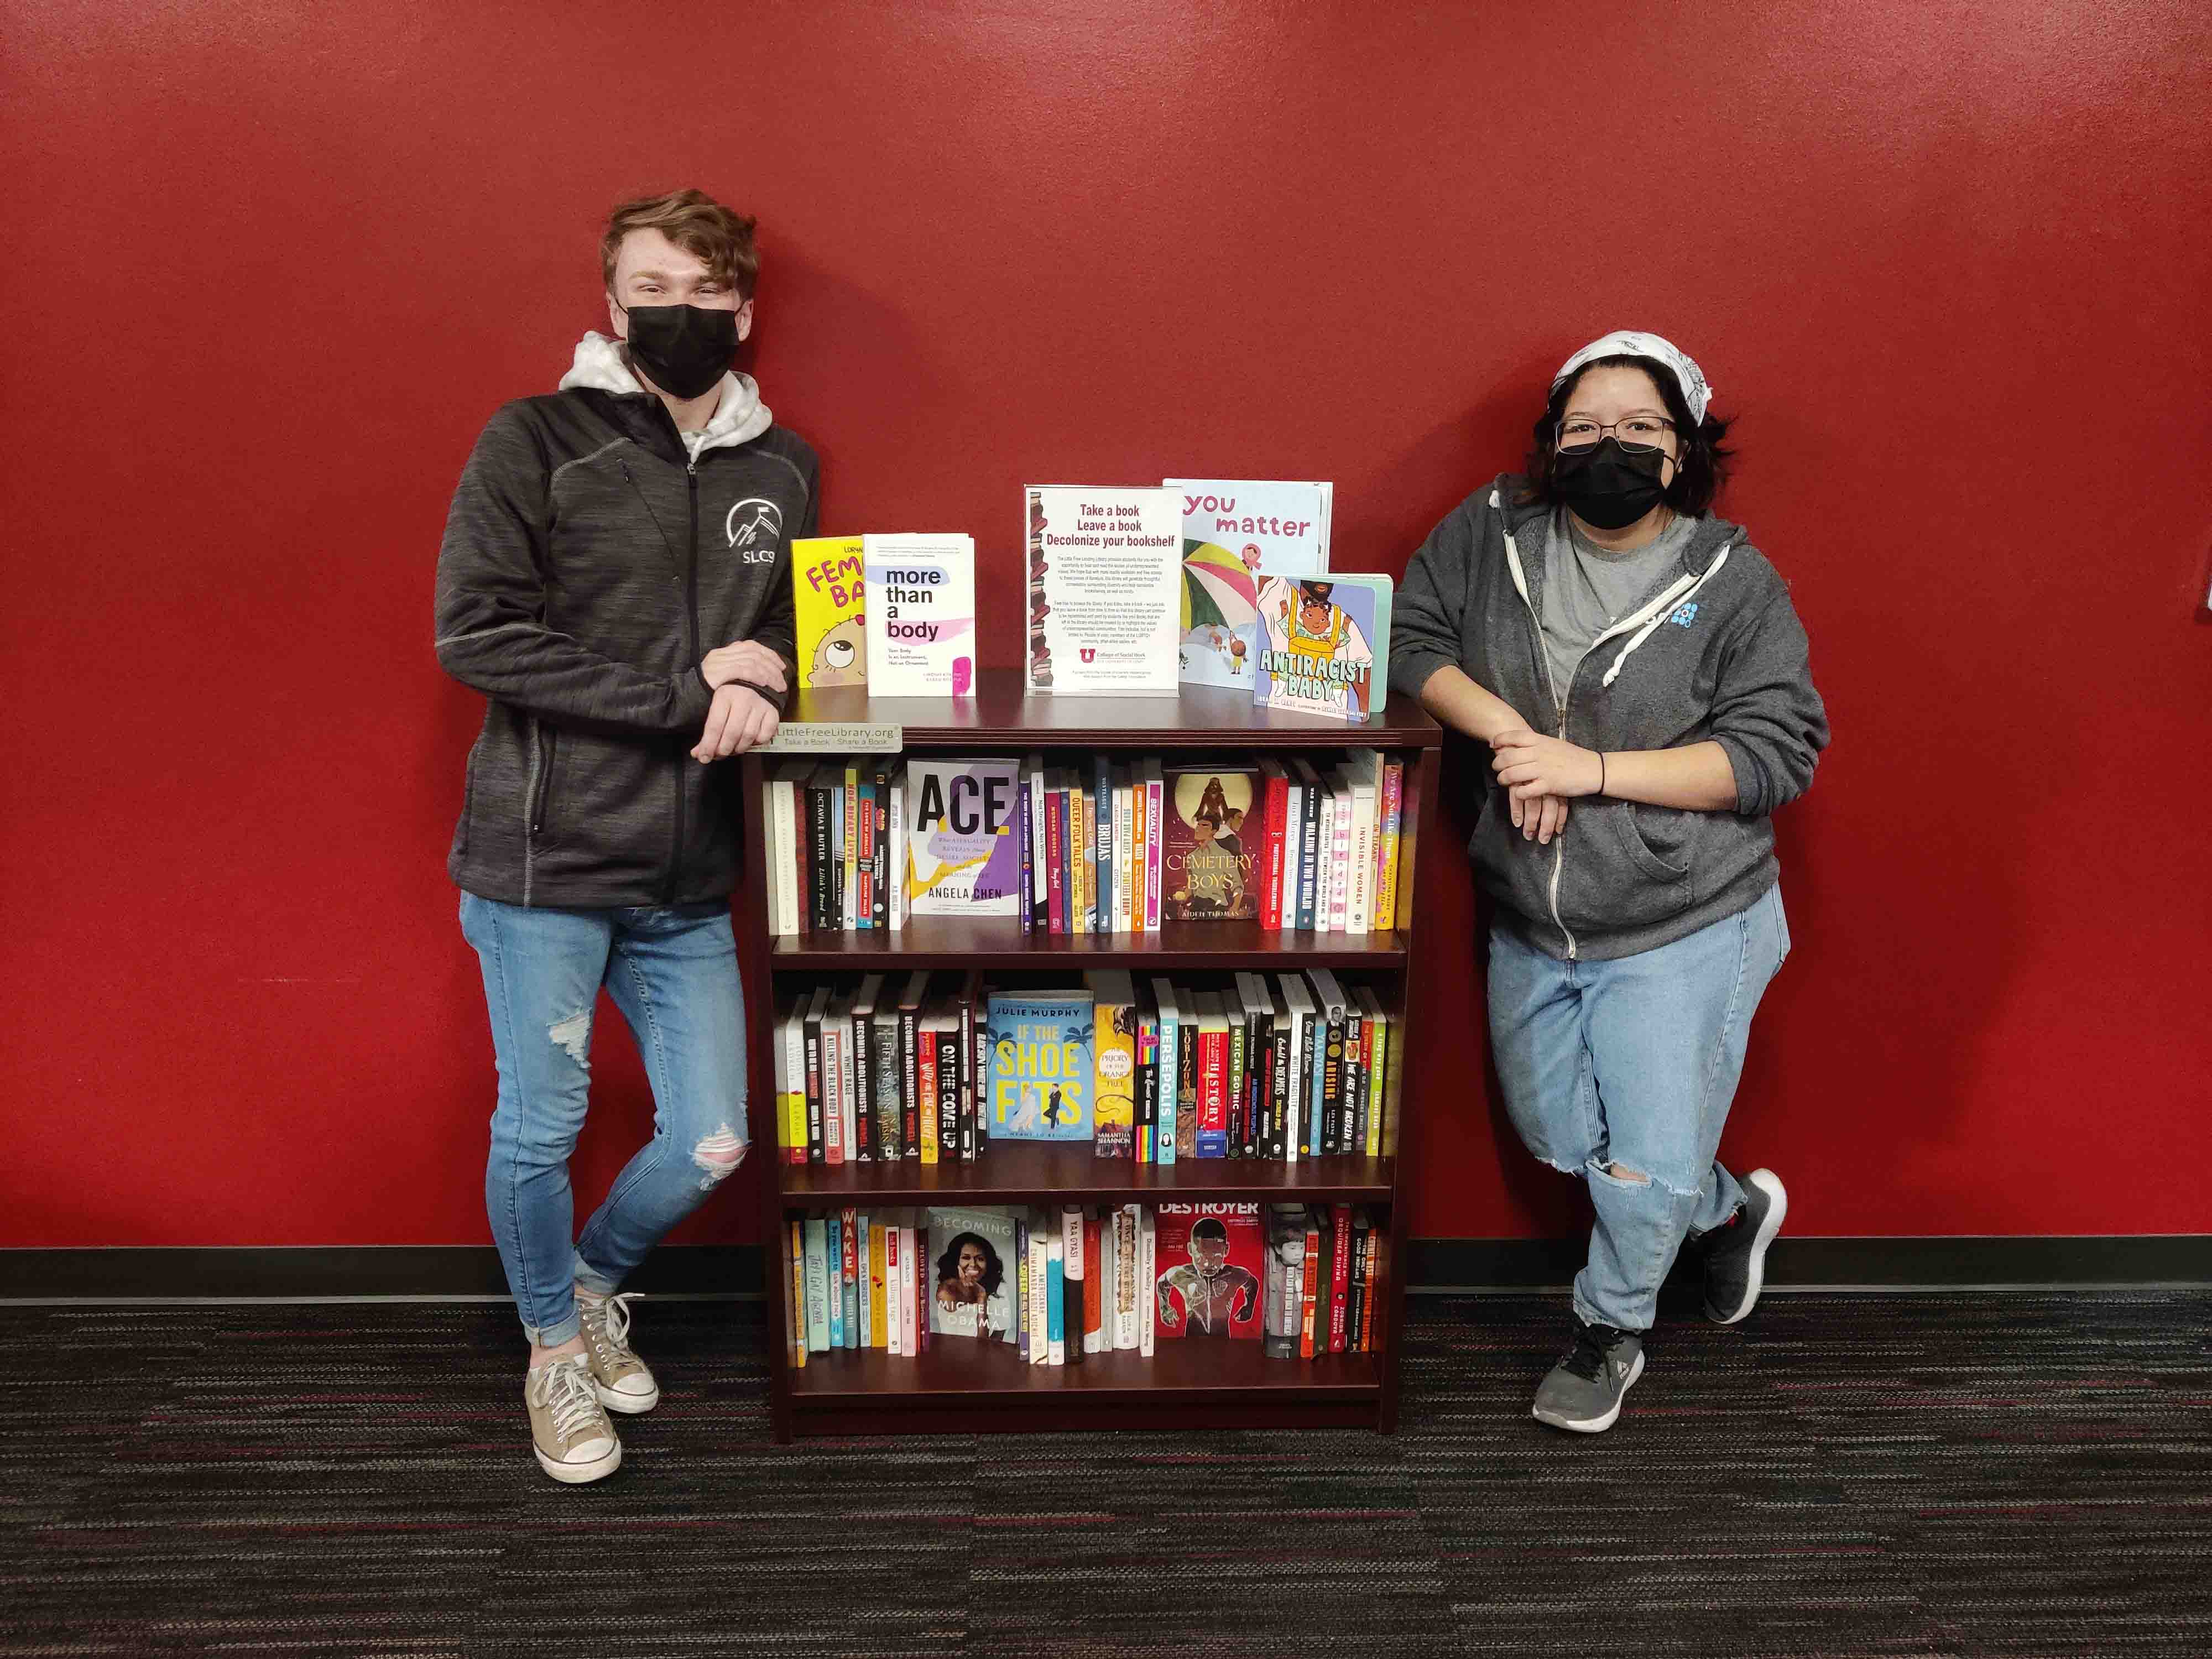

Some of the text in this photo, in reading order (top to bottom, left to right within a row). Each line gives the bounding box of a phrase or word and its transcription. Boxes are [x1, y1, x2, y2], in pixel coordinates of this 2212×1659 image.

[1080, 504, 1140, 517] Take a book
[1182, 495, 1235, 515] you
[1077, 519, 1142, 531] Leave a book
[1216, 517, 1311, 537] matter
[1047, 534, 1175, 549] Decolonize your bookshelf
[806, 556, 864, 593] FEM
[886, 570, 941, 585] more
[886, 586, 932, 603] than
[886, 606, 898, 618] a
[887, 621, 938, 641] body
[1079, 648, 1095, 663] U
[1259, 649, 1368, 684] ANTIRACIST
[1286, 675, 1335, 702] BABY
[778, 728, 894, 738] LittleFreeLibrary.org
[1390, 773, 1398, 785] We
[917, 774, 1009, 836] ACE
[1072, 797, 1081, 822] QUEER
[1149, 797, 1157, 846] SEXUALITY
[1387, 818, 1395, 834] Like
[1098, 824, 1111, 862] BRUJAS
[1358, 827, 1366, 870] INVISIBLE
[1386, 836, 1394, 858] Them
[1166, 853, 1256, 870] CEMETERY
[1302, 822, 1316, 910] WALKING IN TWO WORLDS
[928, 886, 1002, 899] ANGELA CHEN
[1187, 873, 1234, 890] BOYS
[995, 1008, 1080, 1018] JULIE MURPHY
[1018, 1024, 1058, 1040] IF THE
[856, 1020, 868, 1113] BECOMING ABOLITIONISTS
[904, 1016, 915, 1108] BECOMING ABOLITIONISTS
[997, 1041, 1081, 1078] SHOE
[1314, 1034, 1325, 1076] YAA GYASI
[827, 1037, 838, 1114] KILLING THE BLACK BODY
[881, 1042, 894, 1109] FIFTH SEASON
[1161, 1026, 1173, 1117] PERSEPOLIS
[1274, 1066, 1286, 1095] DREAMERS
[1325, 1061, 1337, 1100] ARISING
[942, 1045, 956, 1149] ON THE COME UP
[997, 1080, 1082, 1124] FITS
[1344, 1063, 1357, 1140] WE ARE NOT BROKEN
[921, 1092, 934, 1140] FIRE HIGH
[1159, 1203, 1259, 1214] DESTROYER
[842, 1211, 854, 1268] WAKE
[936, 1217, 1012, 1237] BECOMING
[1070, 1221, 1078, 1258] YAA GYASI
[808, 1276, 823, 1326] GAY AGENDA
[889, 1279, 898, 1303] killing
[938, 1300, 1009, 1316] MICHELLE
[947, 1315, 1000, 1329] OBAMA
